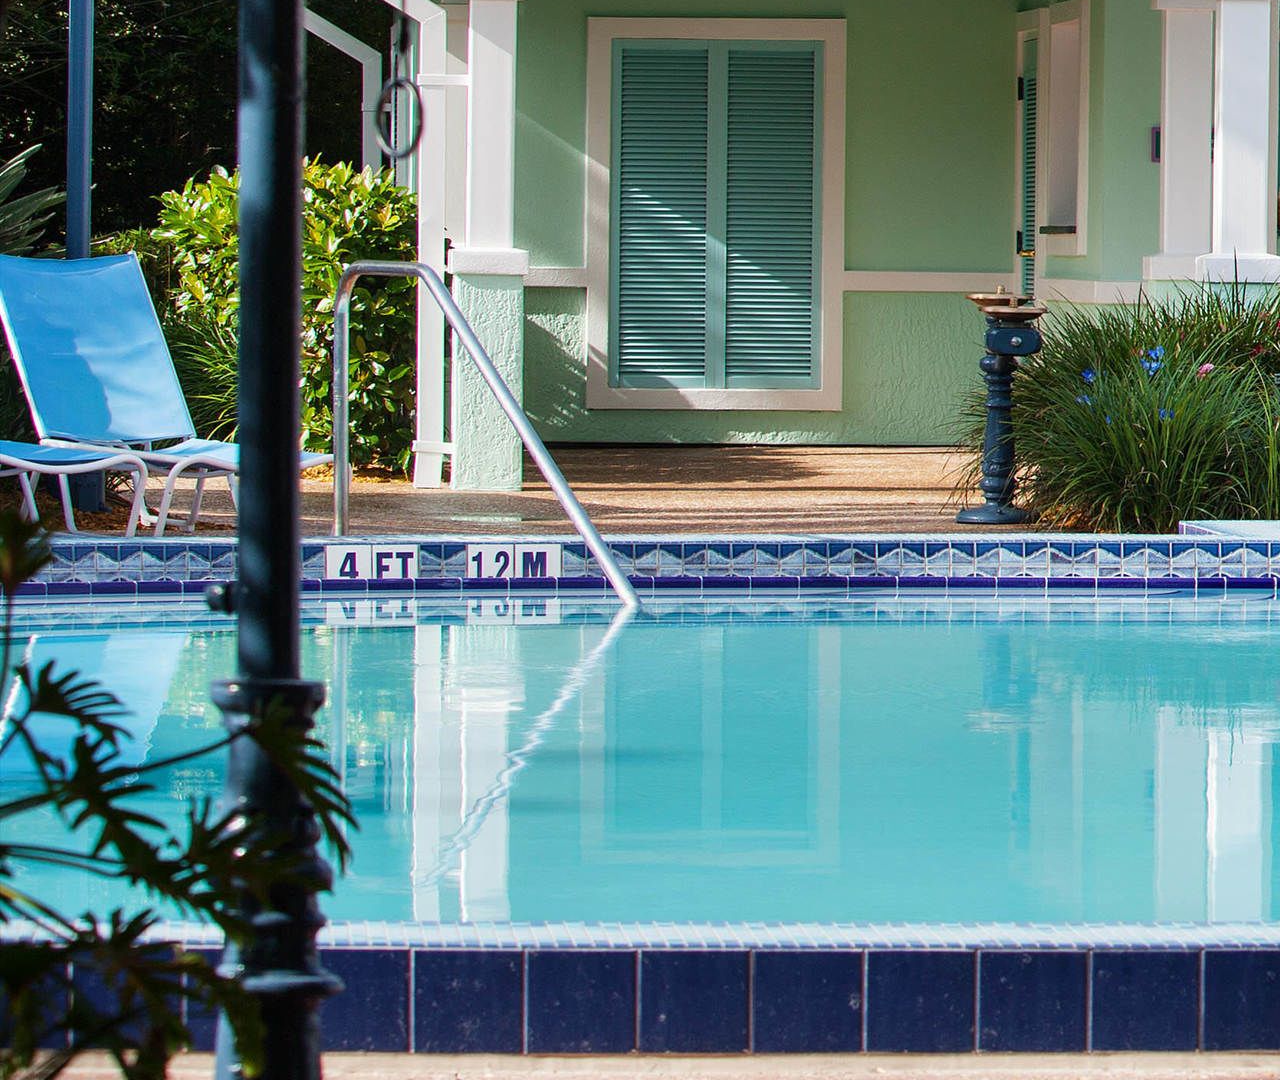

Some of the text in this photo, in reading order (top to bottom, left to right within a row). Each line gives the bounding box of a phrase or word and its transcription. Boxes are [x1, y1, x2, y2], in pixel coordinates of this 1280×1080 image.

[339, 551, 414, 579] 4 FT
[522, 551, 547, 578] M
